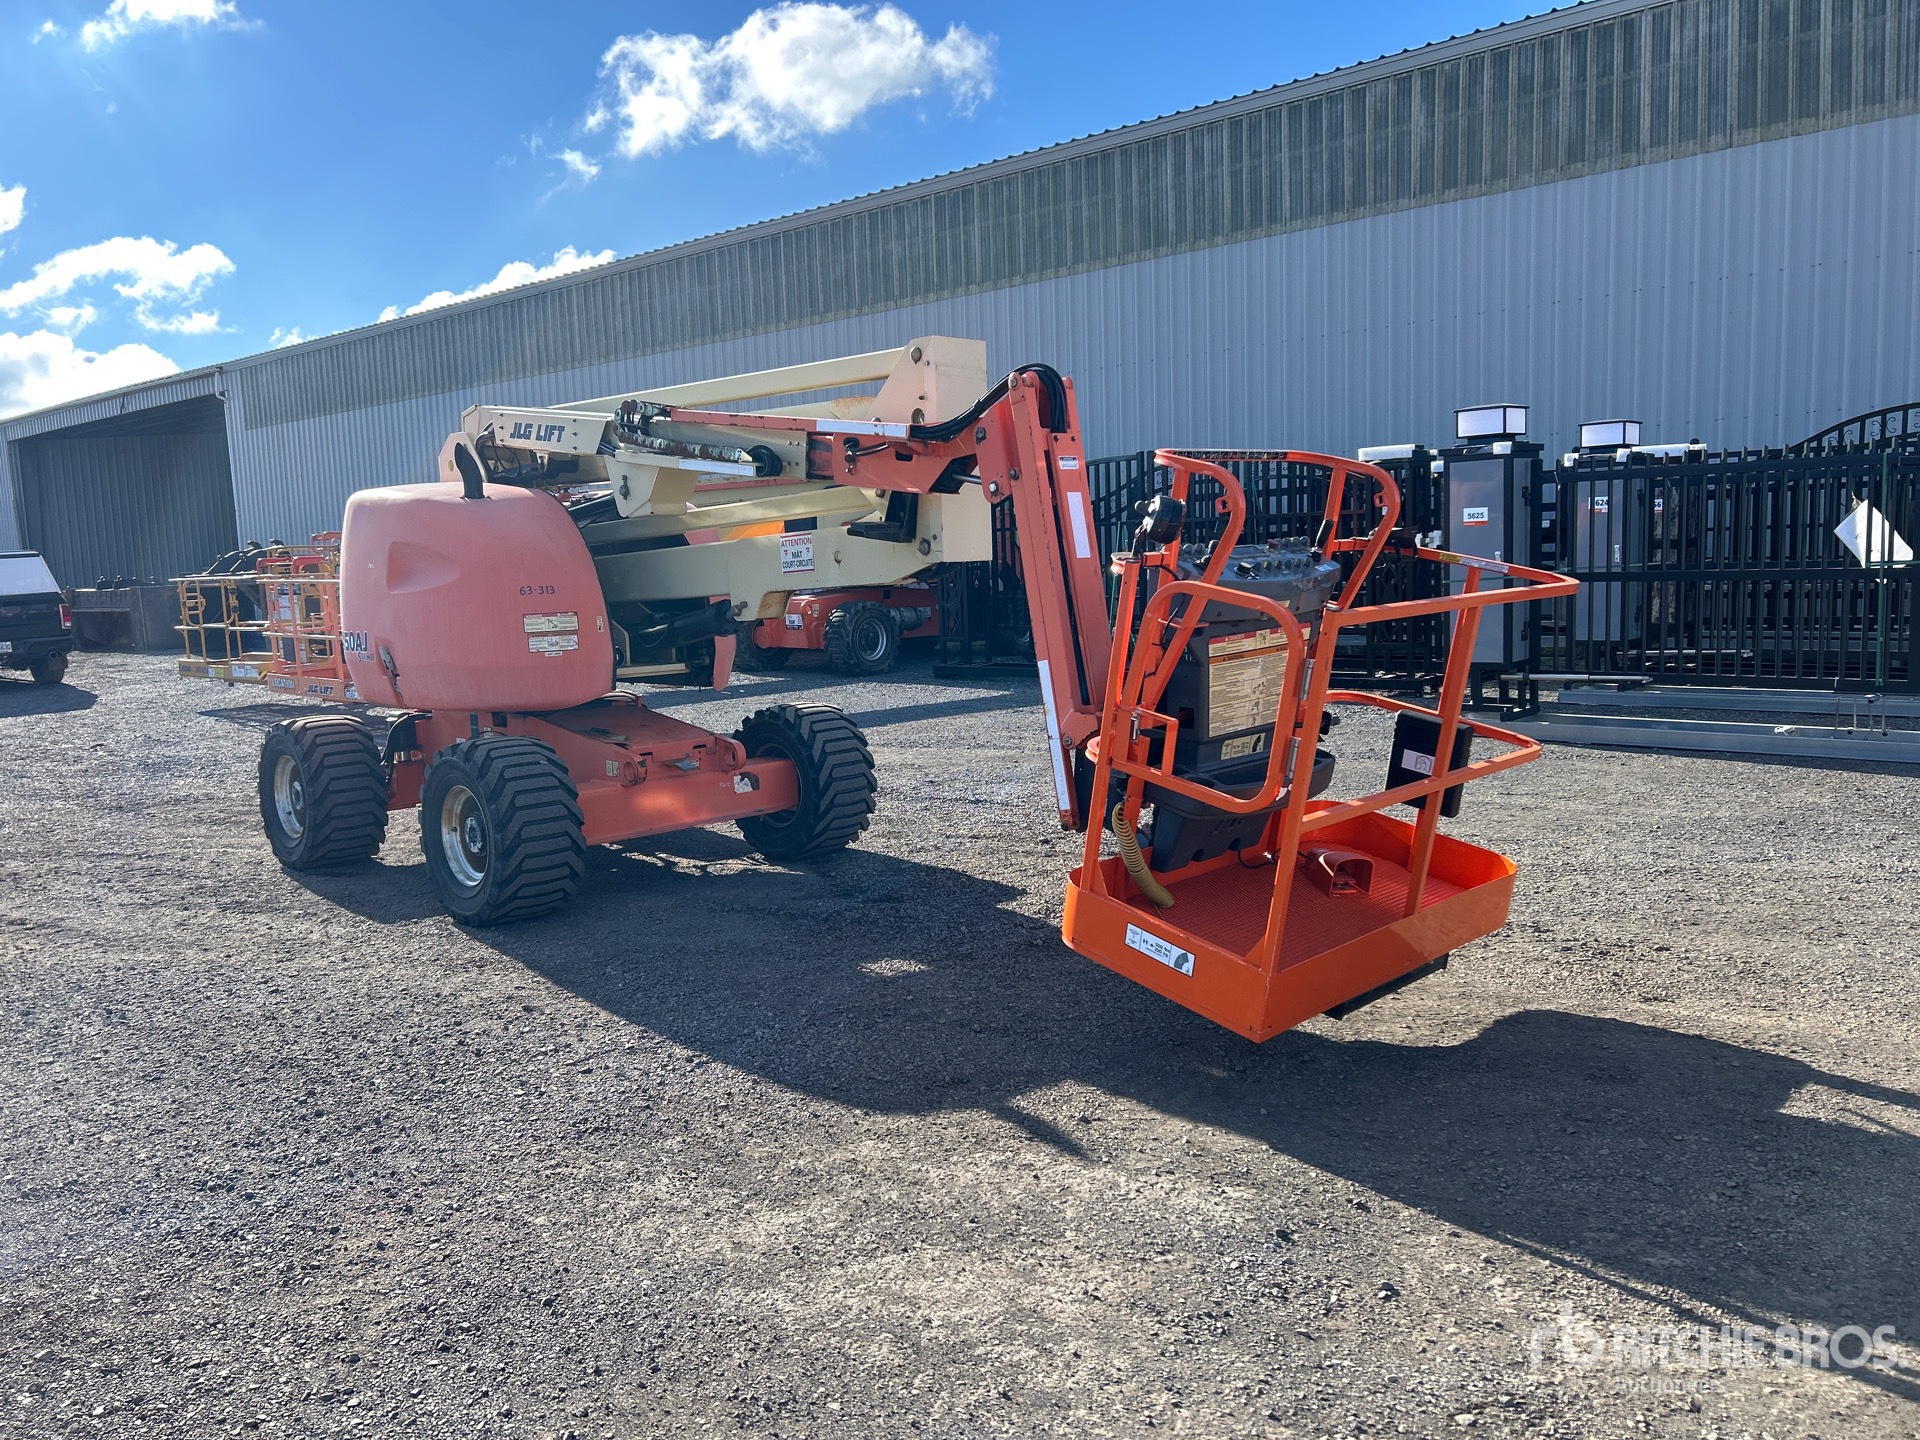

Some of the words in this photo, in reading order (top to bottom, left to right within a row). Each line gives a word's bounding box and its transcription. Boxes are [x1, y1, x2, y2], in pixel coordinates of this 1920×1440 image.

[509, 422, 534, 440] JLG
[535, 423, 566, 443] LIFT
[1467, 511, 1485, 520] 5625
[780, 537, 812, 548] ATTENTION
[519, 585, 556, 596] 63-313
[271, 676, 296, 690] LOCATION
[307, 684, 319, 694] JLG
[319, 685, 334, 696] LIFT
